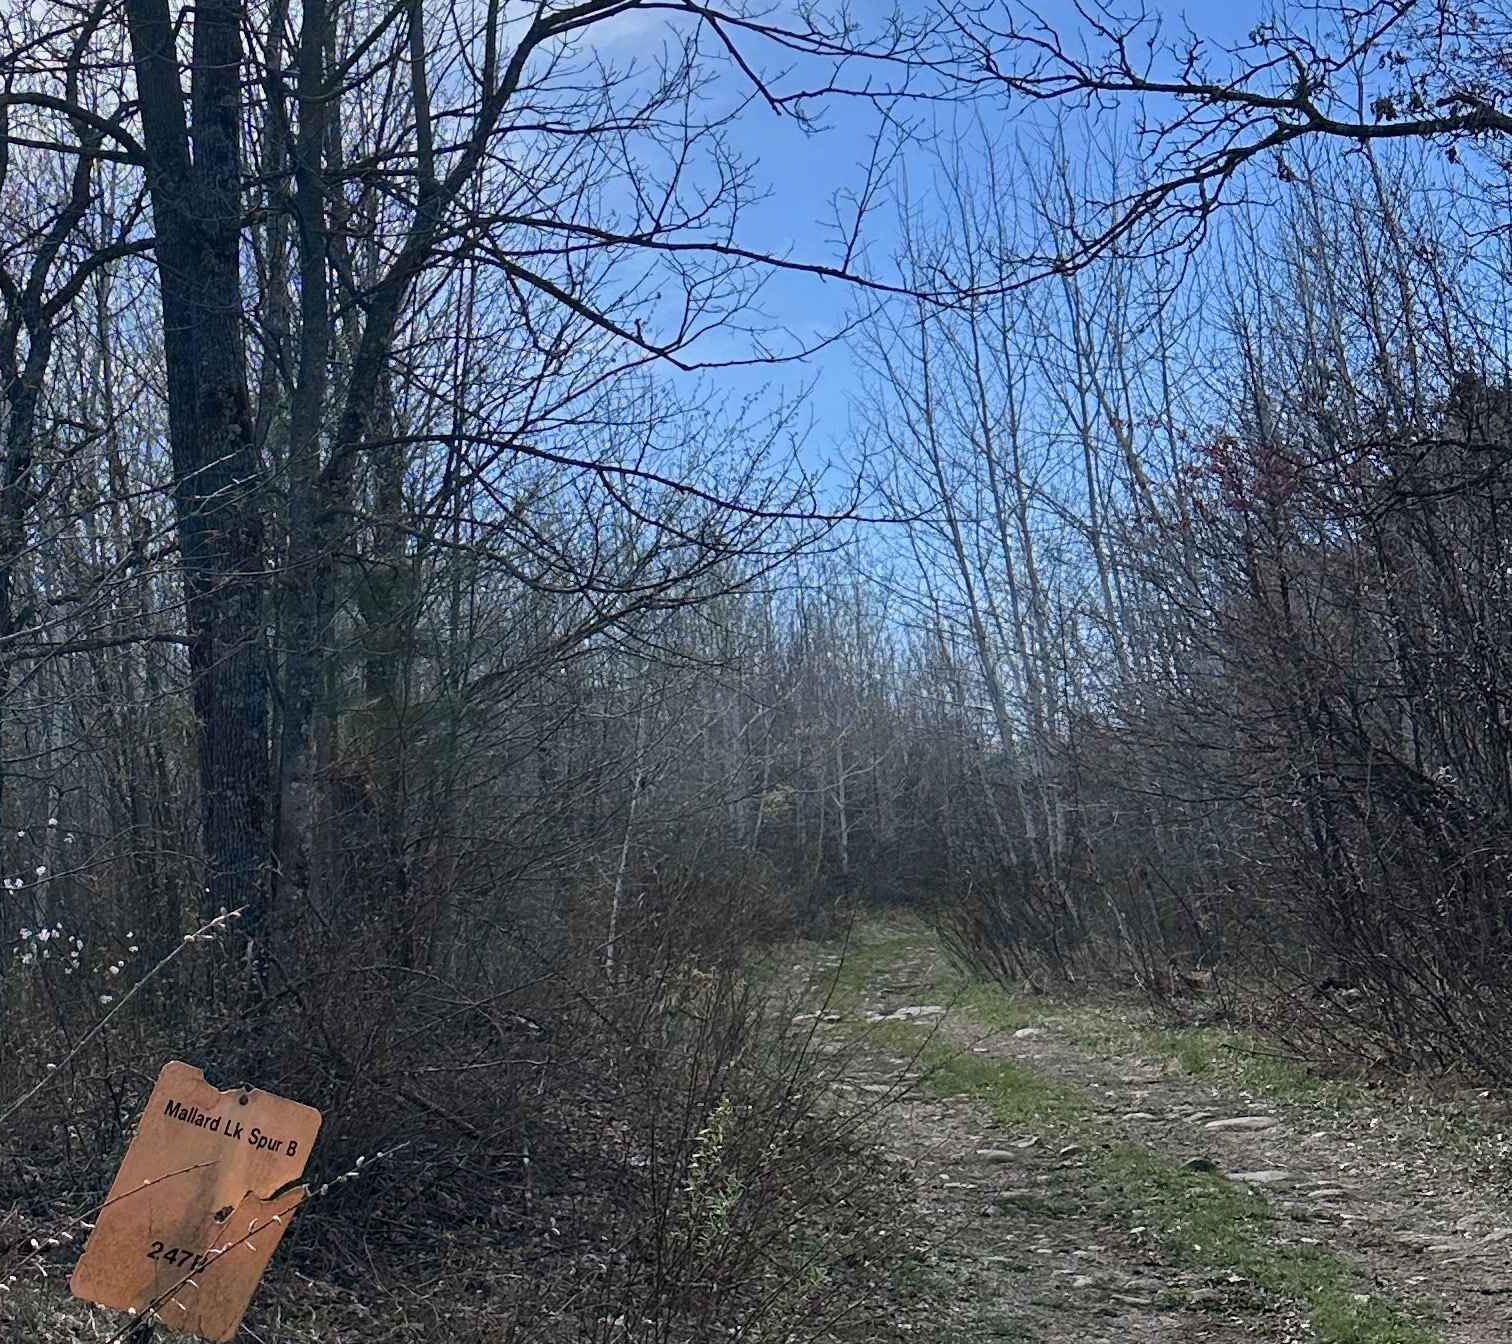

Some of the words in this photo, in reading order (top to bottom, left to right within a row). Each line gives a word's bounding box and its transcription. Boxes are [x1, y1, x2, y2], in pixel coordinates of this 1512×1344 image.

[164, 1099, 221, 1132] Mallard
[224, 1119, 244, 1140] Lk
[248, 1127, 283, 1150] Spur
[285, 1140, 298, 1157] B
